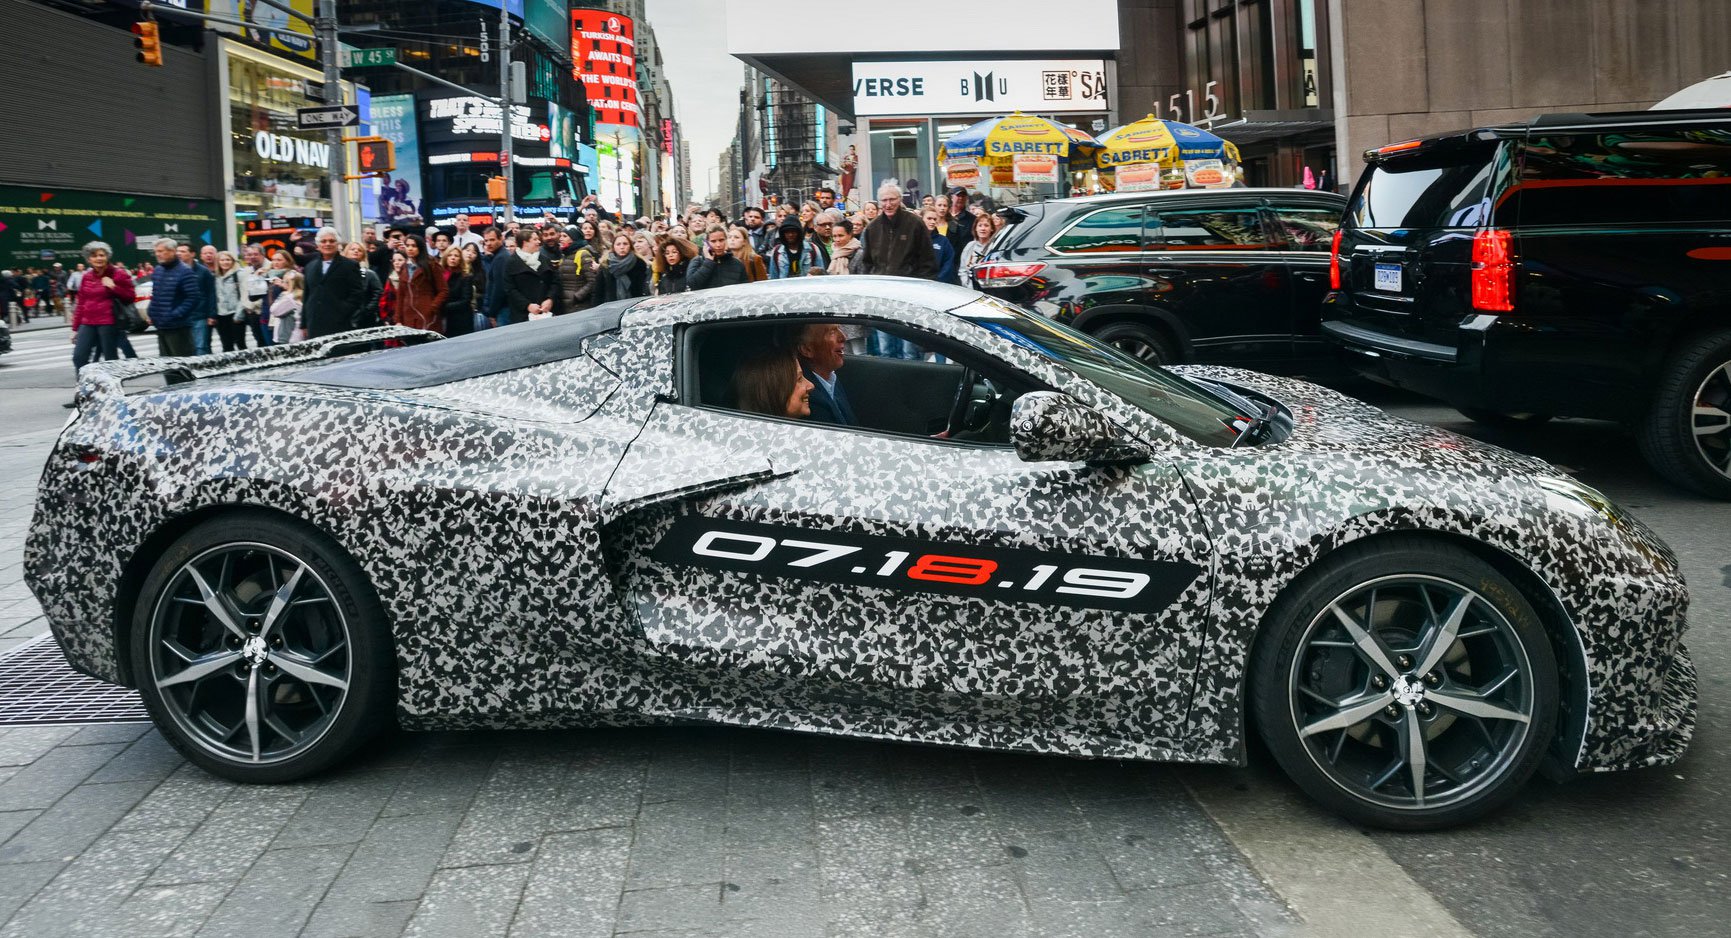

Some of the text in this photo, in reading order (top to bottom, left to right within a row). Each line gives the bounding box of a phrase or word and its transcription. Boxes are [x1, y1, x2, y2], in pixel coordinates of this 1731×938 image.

[353, 52, 364, 64] W
[369, 51, 382, 63] 45
[588, 50, 621, 62] AWAITS
[580, 74, 599, 84] THE
[1153, 80, 1220, 122] 1515
[306, 114, 324, 123] ONE
[332, 112, 350, 121] WAY
[370, 105, 404, 119] BLESS
[256, 130, 330, 168] OLD NAV
[991, 141, 1064, 153] SABRETT
[1101, 147, 1169, 165] SABRETT
[691, 531, 1151, 599] 07.18.19
